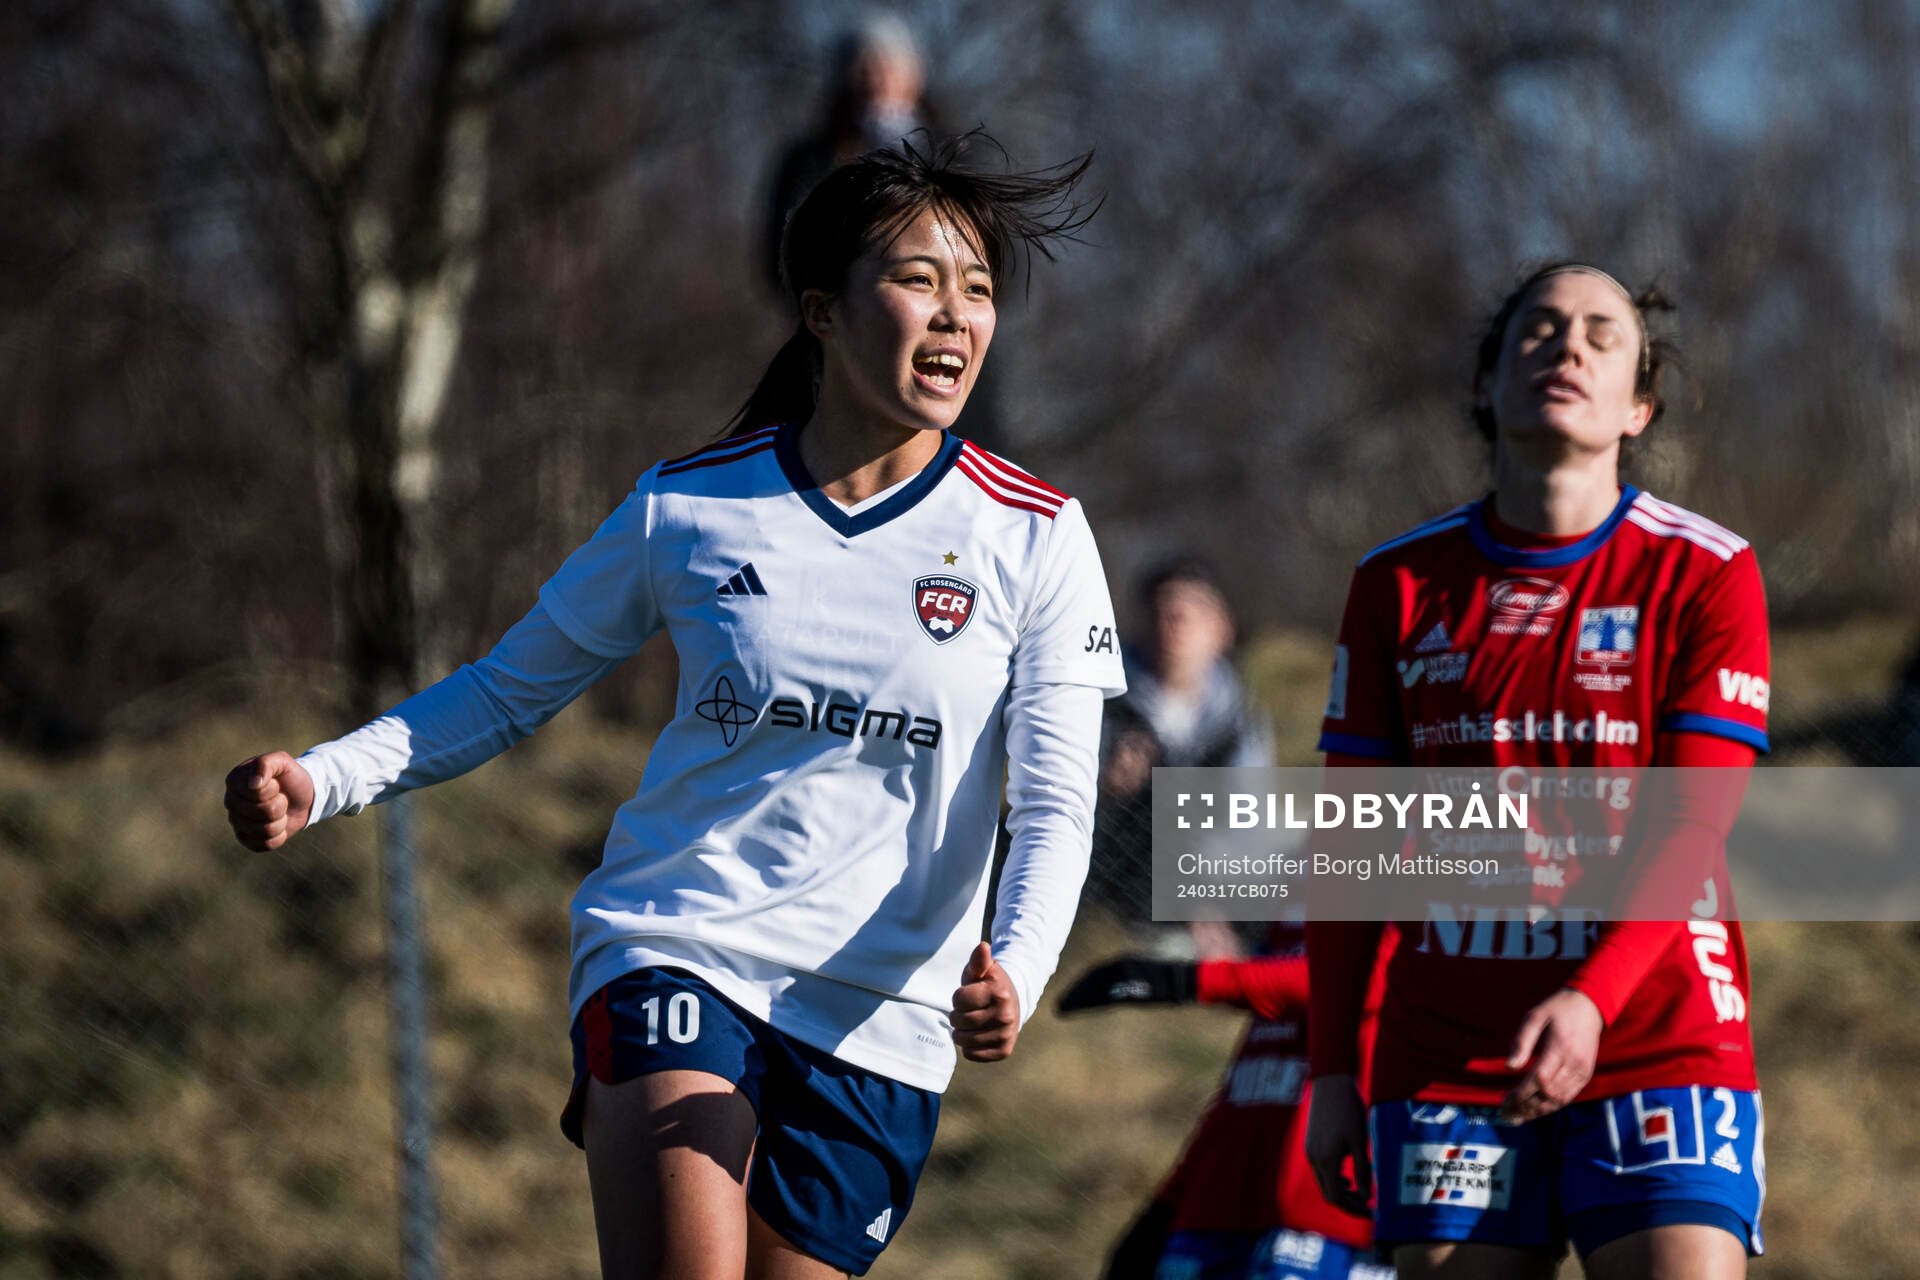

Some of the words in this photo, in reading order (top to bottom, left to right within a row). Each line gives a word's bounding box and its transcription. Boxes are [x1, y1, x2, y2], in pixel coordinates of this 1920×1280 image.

[921, 591, 968, 613] FCR
[1084, 625, 1119, 655] SA
[1717, 668, 1770, 713] VIC
[641, 991, 700, 1045] 10
[1713, 1086, 1740, 1140] 2
